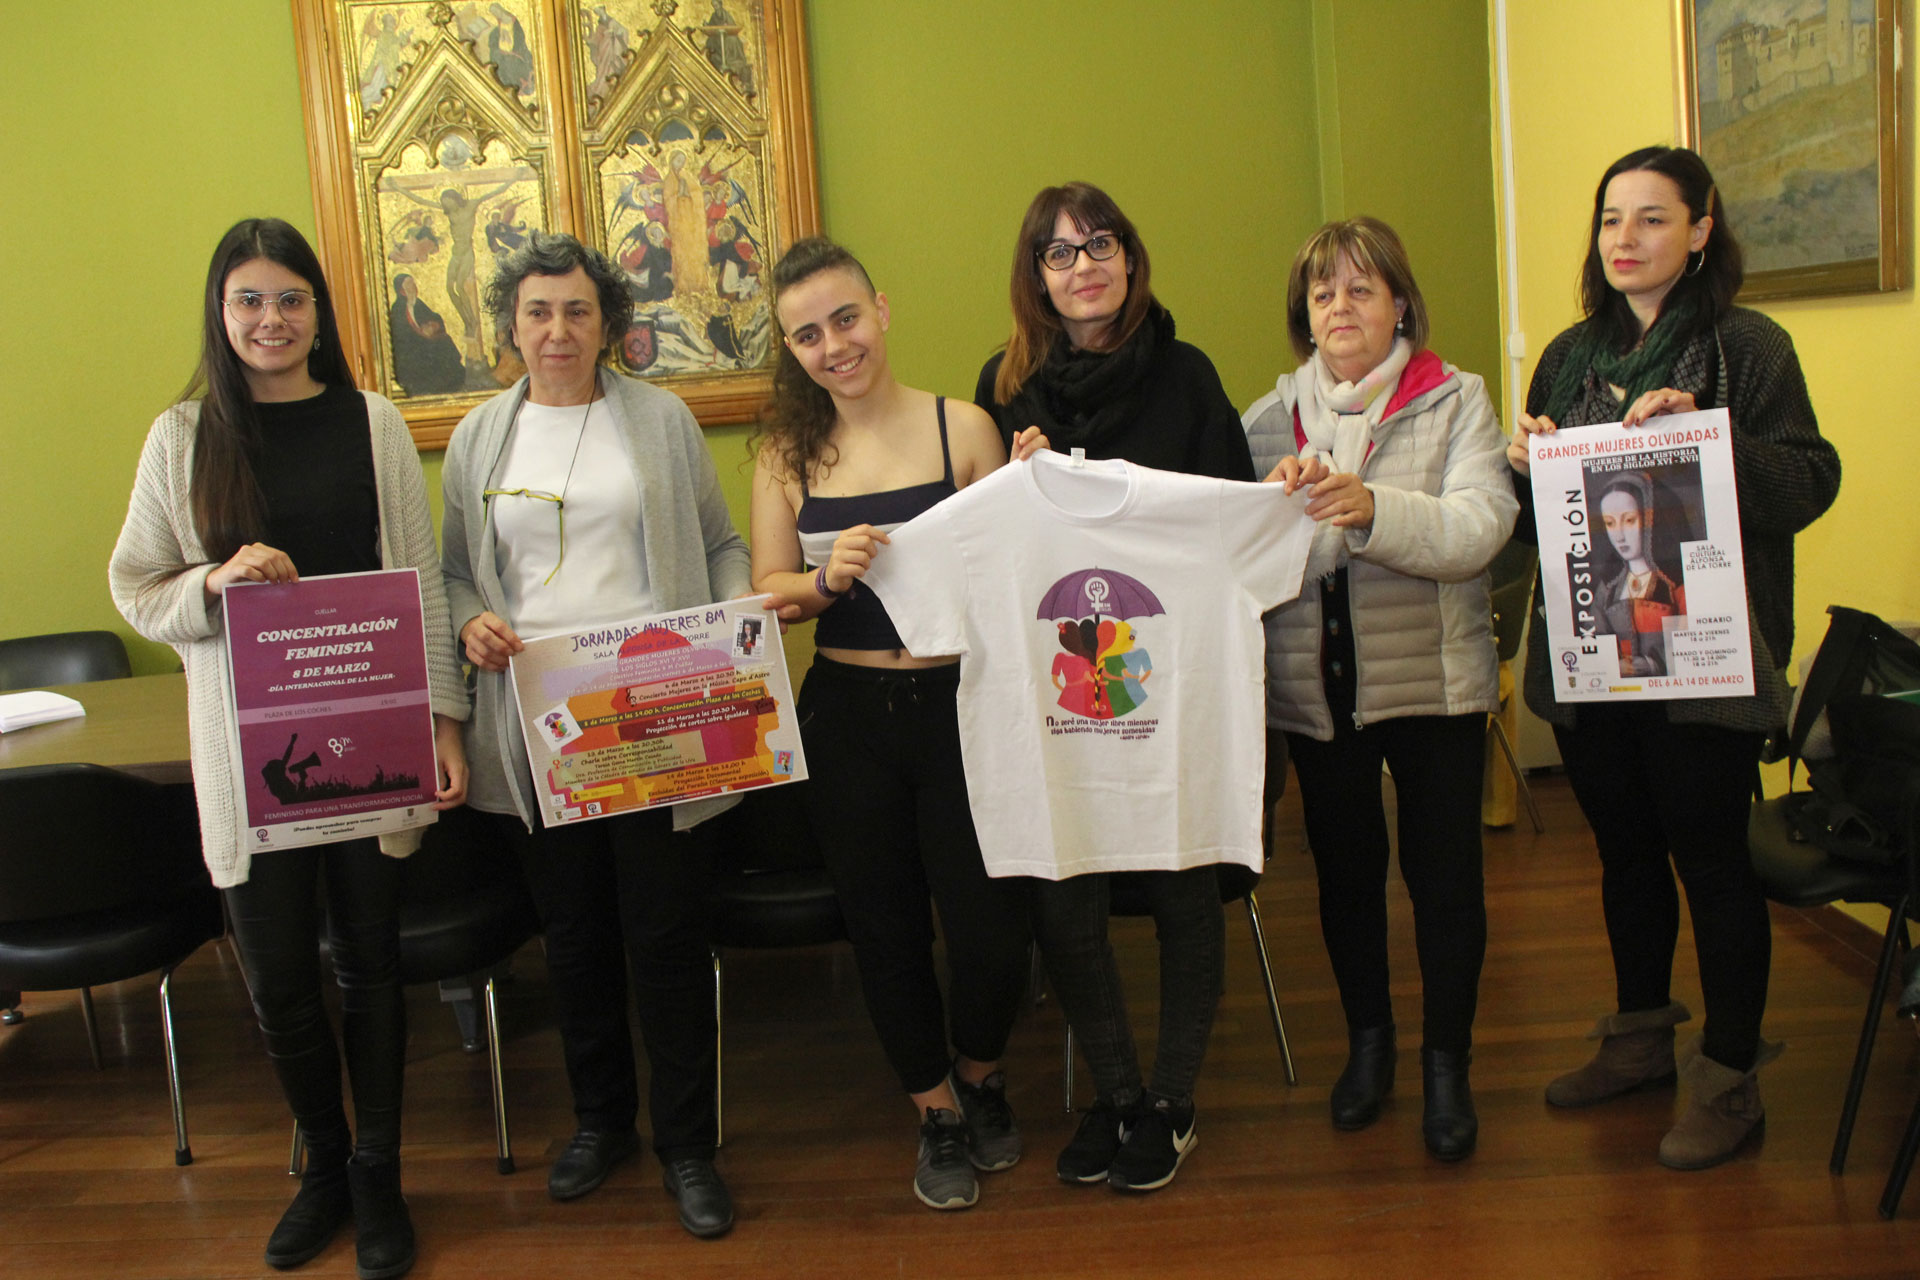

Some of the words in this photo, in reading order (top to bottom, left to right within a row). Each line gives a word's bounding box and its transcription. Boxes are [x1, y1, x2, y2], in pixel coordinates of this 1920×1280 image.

[1537, 446, 1590, 460] GRANDES
[1594, 436, 1644, 454] MUJERES
[1648, 427, 1720, 448] OLVIDADAS
[1582, 456, 1623, 468] MUJERES
[1652, 448, 1696, 459] HISTORIA
[1605, 464, 1622, 472] LOS
[1623, 460, 1656, 470] SIGLOS
[1680, 454, 1699, 464] XVII
[1690, 550, 1725, 558] CULTURAL
[1563, 490, 1598, 654] EXPOSICIÓN
[1696, 616, 1732, 624] HORARIO
[257, 616, 398, 642] CONCENTRACIÓN
[571, 626, 638, 652] JORNADAS
[644, 614, 700, 635] MUJERES
[706, 609, 726, 624] 8M
[285, 641, 374, 660] FEMINISTA
[594, 650, 614, 659] SALA
[618, 643, 652, 654] ALFONSA
[684, 632, 710, 641] TORRE
[620, 656, 648, 664] GRANDES
[652, 649, 681, 658] MUJERES
[293, 670, 301, 678] 8
[303, 667, 322, 678] DE
[324, 662, 370, 675] MARZO
[636, 661, 658, 670] SIGLOS
[285, 678, 346, 690] INTERNACIONAL
[1648, 679, 1662, 688] DEL
[1686, 678, 1696, 686] 14
[1698, 676, 1709, 685] DE
[1712, 675, 1744, 684] MARZO
[639, 692, 666, 700] Concierto
[669, 688, 692, 696] Mujeres
[600, 716, 618, 724] Marzo
[662, 700, 704, 712] Concentración
[706, 697, 722, 706] Plaza
[742, 689, 760, 698] Coches
[646, 725, 678, 734] Proyección
[724, 710, 750, 720] igualdad
[1061, 718, 1074, 726] seré
[618, 744, 672, 758] Corresponsabilidad
[674, 776, 704, 785] Proyección
[706, 768, 740, 779] Documental
[648, 788, 674, 796] Excluidas
[264, 810, 304, 820] FEMINISMO
[340, 796, 400, 810] TRANSFORMACIÓN
